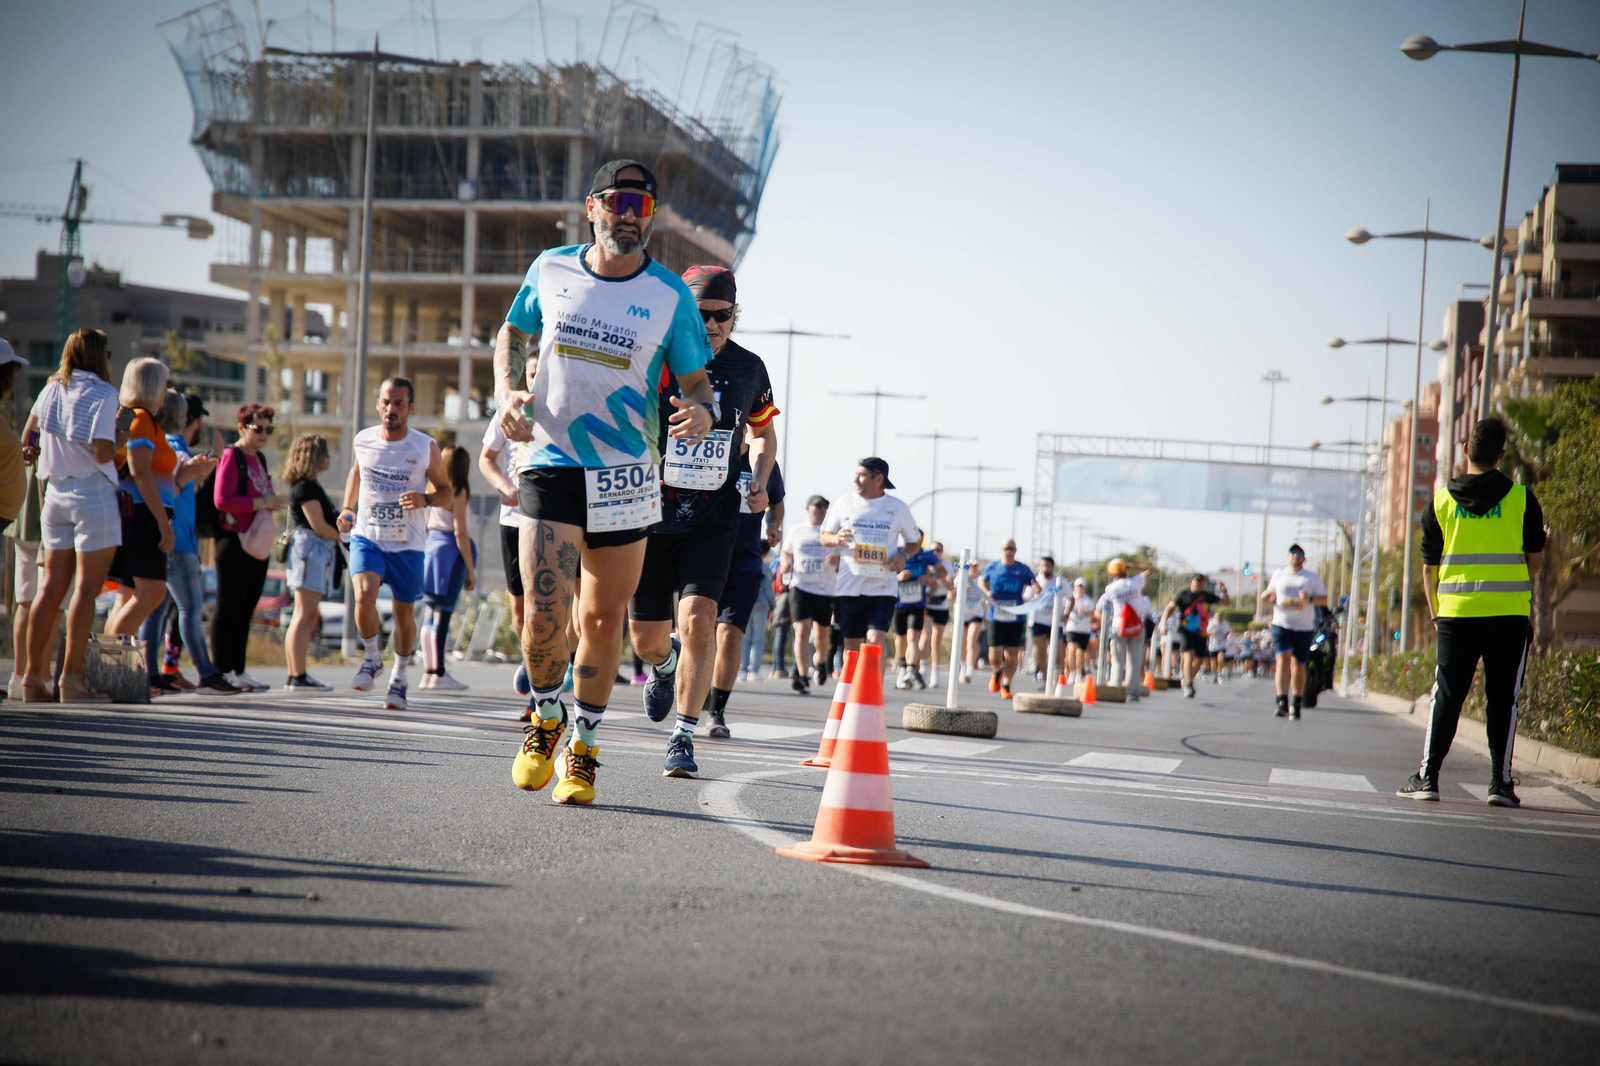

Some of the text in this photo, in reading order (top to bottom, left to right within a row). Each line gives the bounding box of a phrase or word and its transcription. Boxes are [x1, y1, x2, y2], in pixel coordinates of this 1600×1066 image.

[556, 310, 637, 338] Medio Maratón
[555, 321, 635, 350] Almería 2022
[580, 340, 597, 350] RUIZ
[598, 345, 632, 359] ANDÚJAR
[674, 438, 726, 459] 5786
[597, 463, 655, 492] 5504
[599, 489, 635, 499] BERNARDO
[371, 507, 404, 520] 5554
[1455, 503, 1502, 519] NA
[857, 549, 883, 560] 1681
